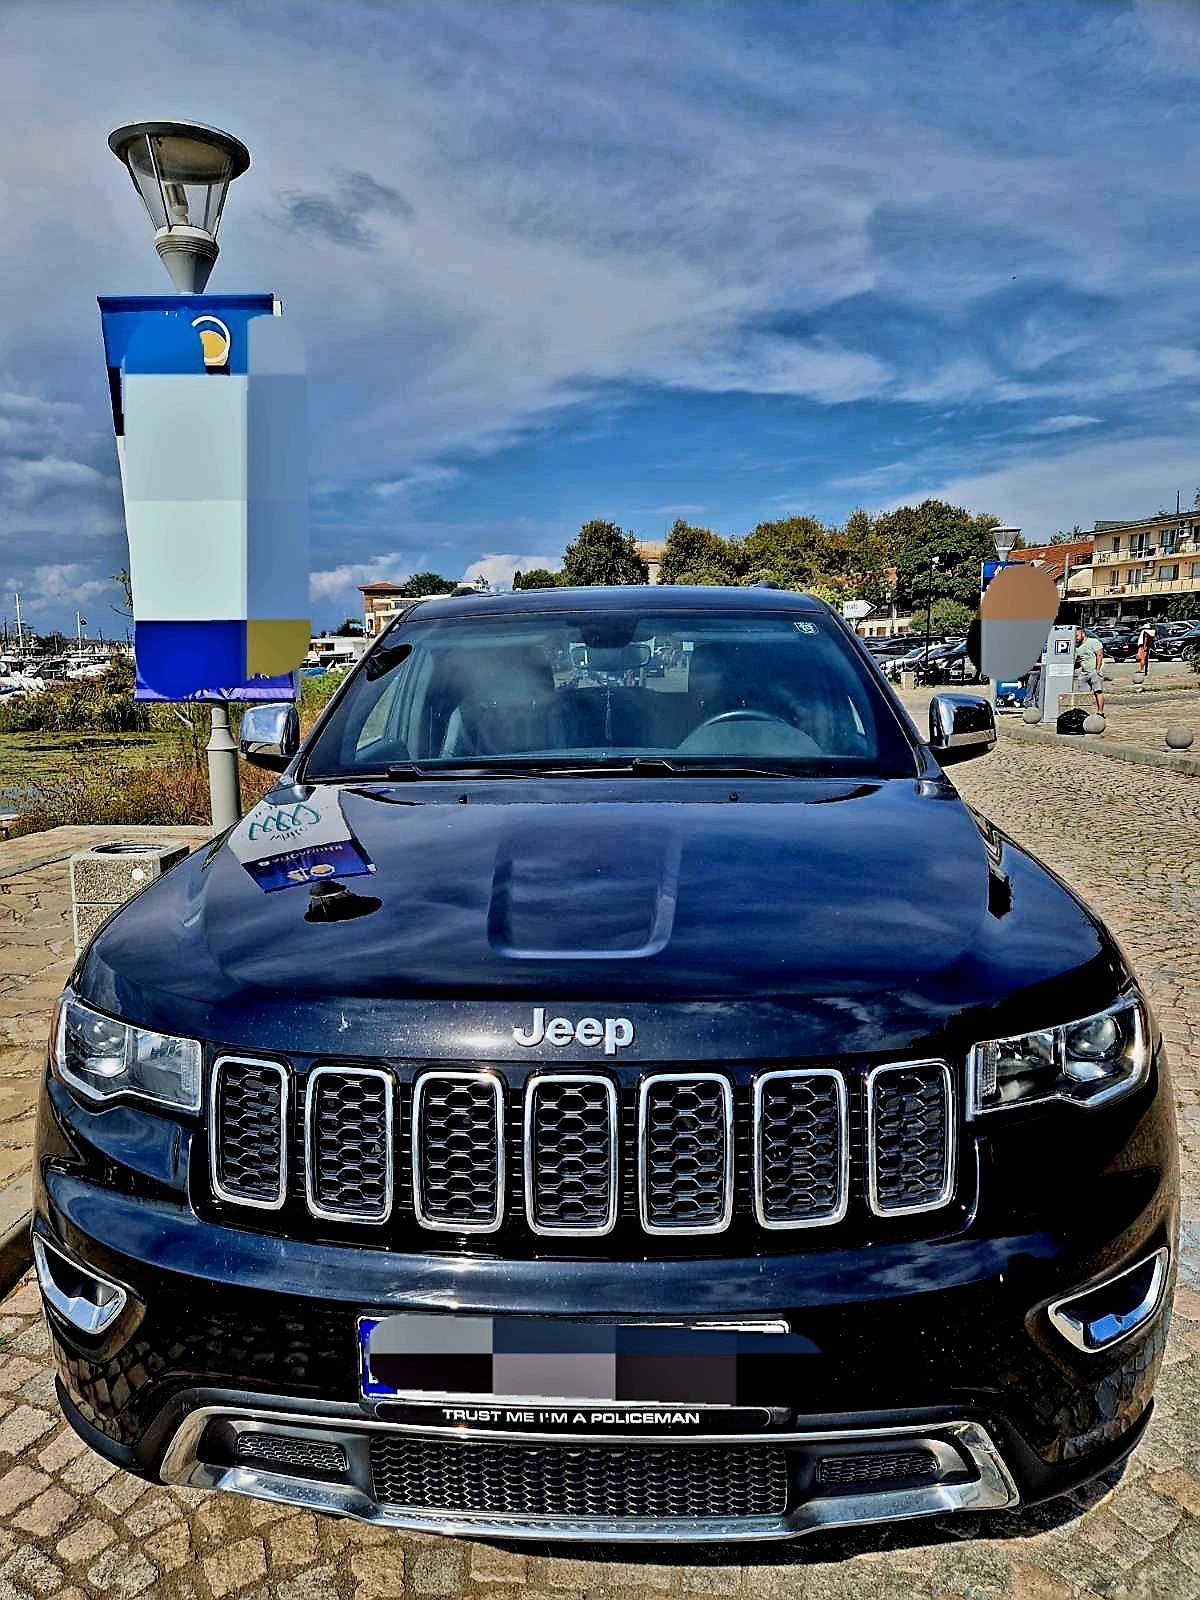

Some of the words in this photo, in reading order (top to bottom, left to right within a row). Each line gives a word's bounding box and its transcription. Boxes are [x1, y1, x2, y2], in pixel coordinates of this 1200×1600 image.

[512, 1007, 634, 1056] Jeep
[442, 1408, 501, 1422] TRUST
[506, 1411, 535, 1423] ME
[539, 1412, 568, 1424] I'M
[572, 1413, 587, 1424] A
[590, 1413, 700, 1425] POLICEMAN
